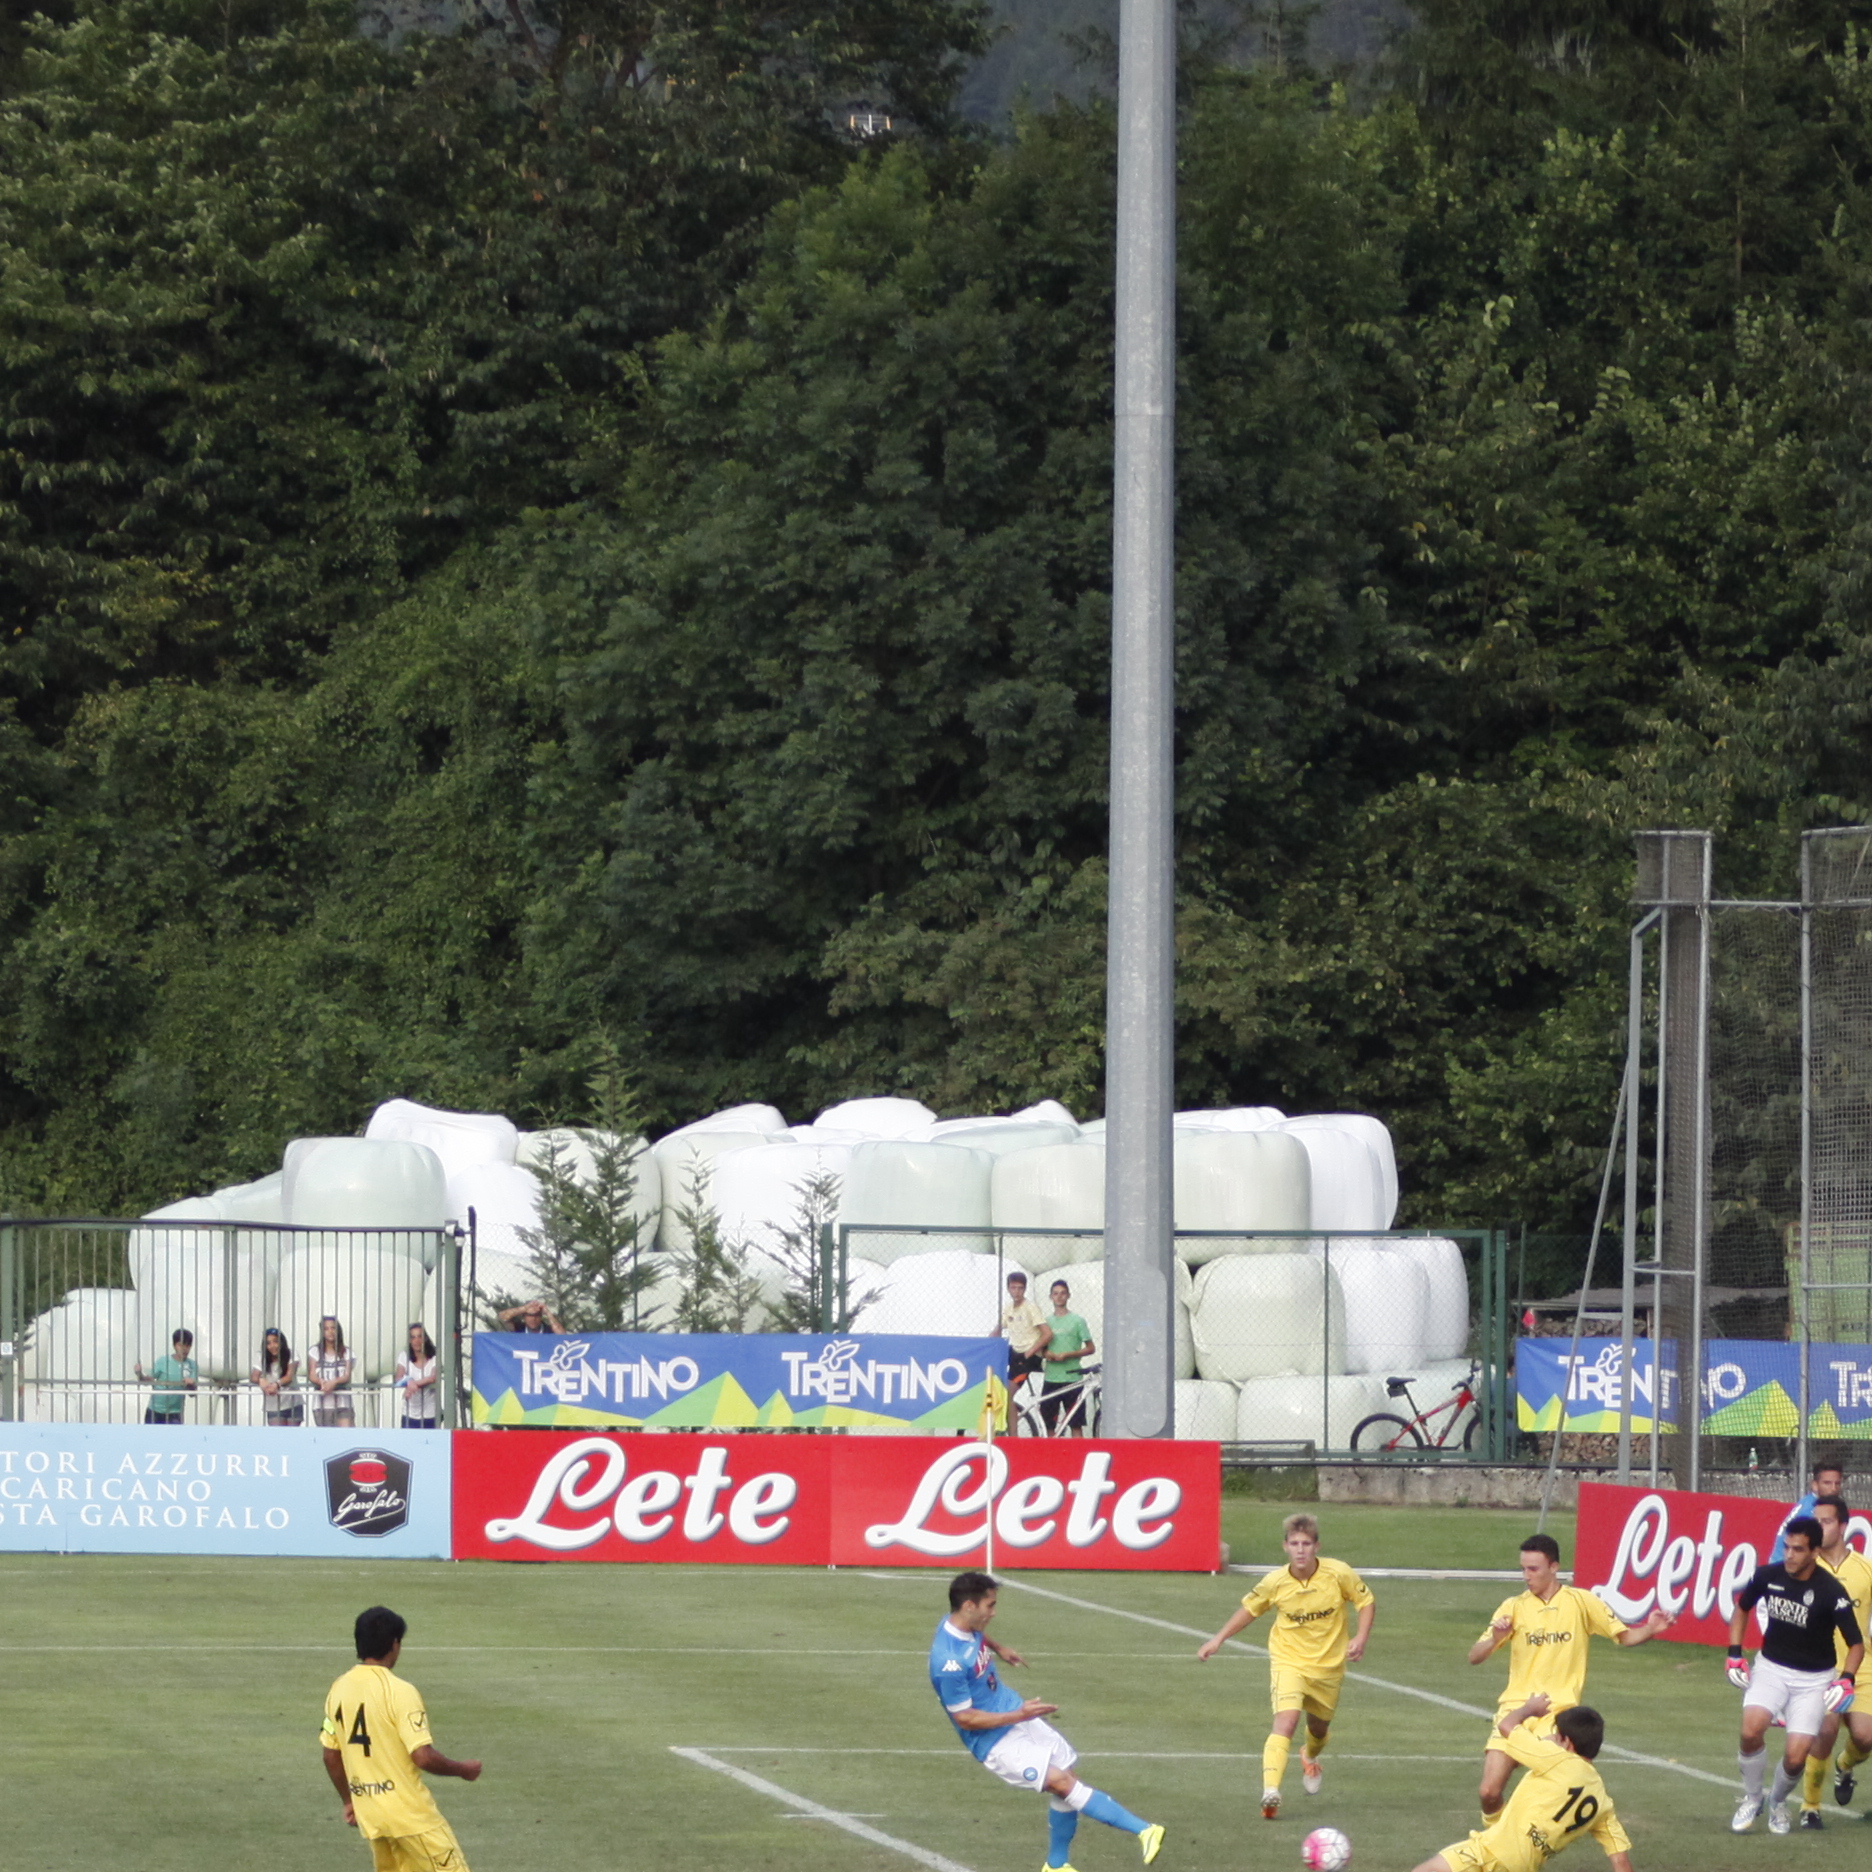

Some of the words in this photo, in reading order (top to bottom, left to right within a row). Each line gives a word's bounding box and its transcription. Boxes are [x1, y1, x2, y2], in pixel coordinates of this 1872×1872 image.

[512, 1350, 700, 1403] TRENTINO
[781, 1351, 968, 1404] TRENTINO
[118, 1452, 291, 1477] AZZURRI
[80, 1505, 290, 1530] GAROFALO
[333, 1489, 406, 1530] Garofalo
[485, 1437, 797, 1551] Lete
[865, 1441, 1181, 1557] Lete
[1591, 1494, 1758, 1624] Lete
[1525, 1630, 1572, 1647] TRENTINO
[334, 1702, 371, 1758] 14
[1552, 1786, 1599, 1834] 19
